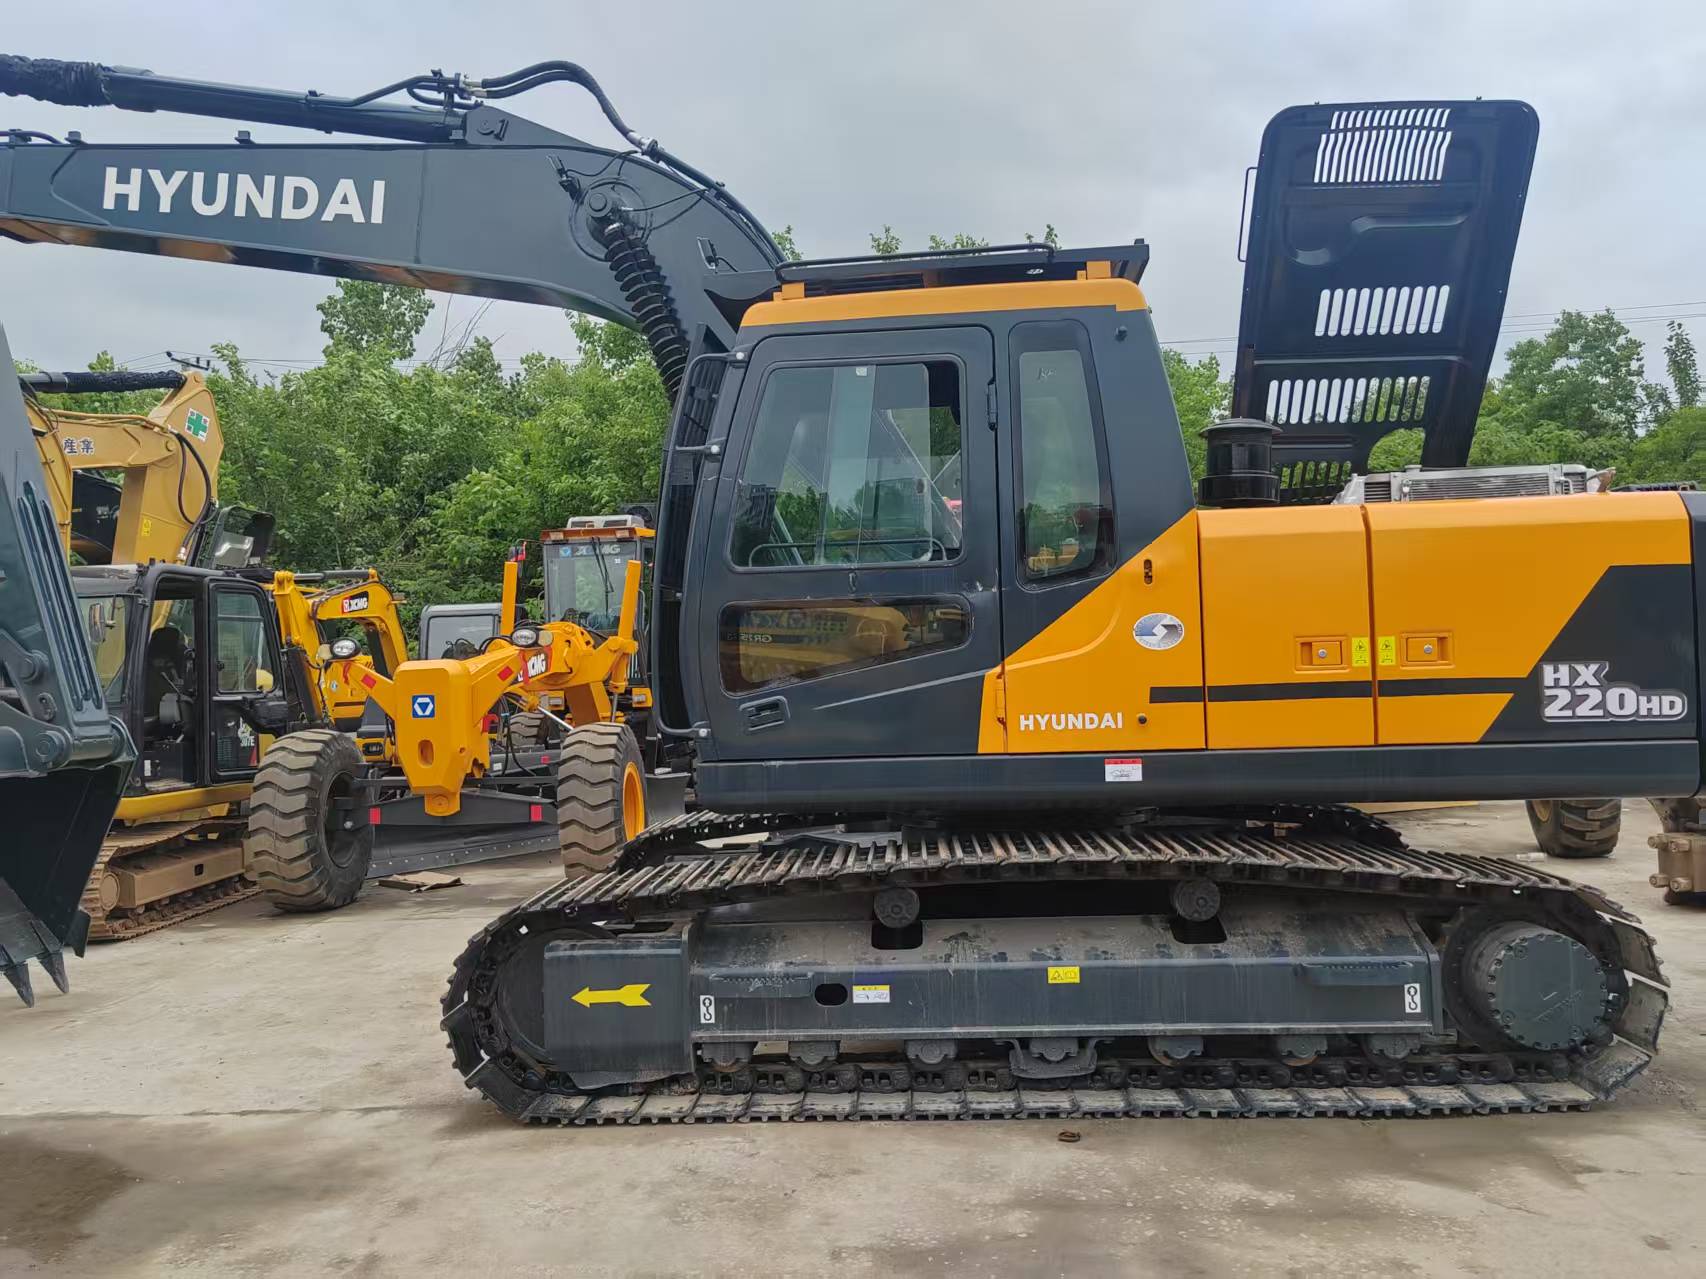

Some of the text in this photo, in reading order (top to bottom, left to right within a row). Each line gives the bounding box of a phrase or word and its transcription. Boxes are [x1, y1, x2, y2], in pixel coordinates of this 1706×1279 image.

[103, 166, 386, 225] HYUNDAI
[1543, 663, 1601, 687] HX
[1543, 687, 1683, 717] 220HD
[1019, 712, 1123, 731] HYUNDAI
